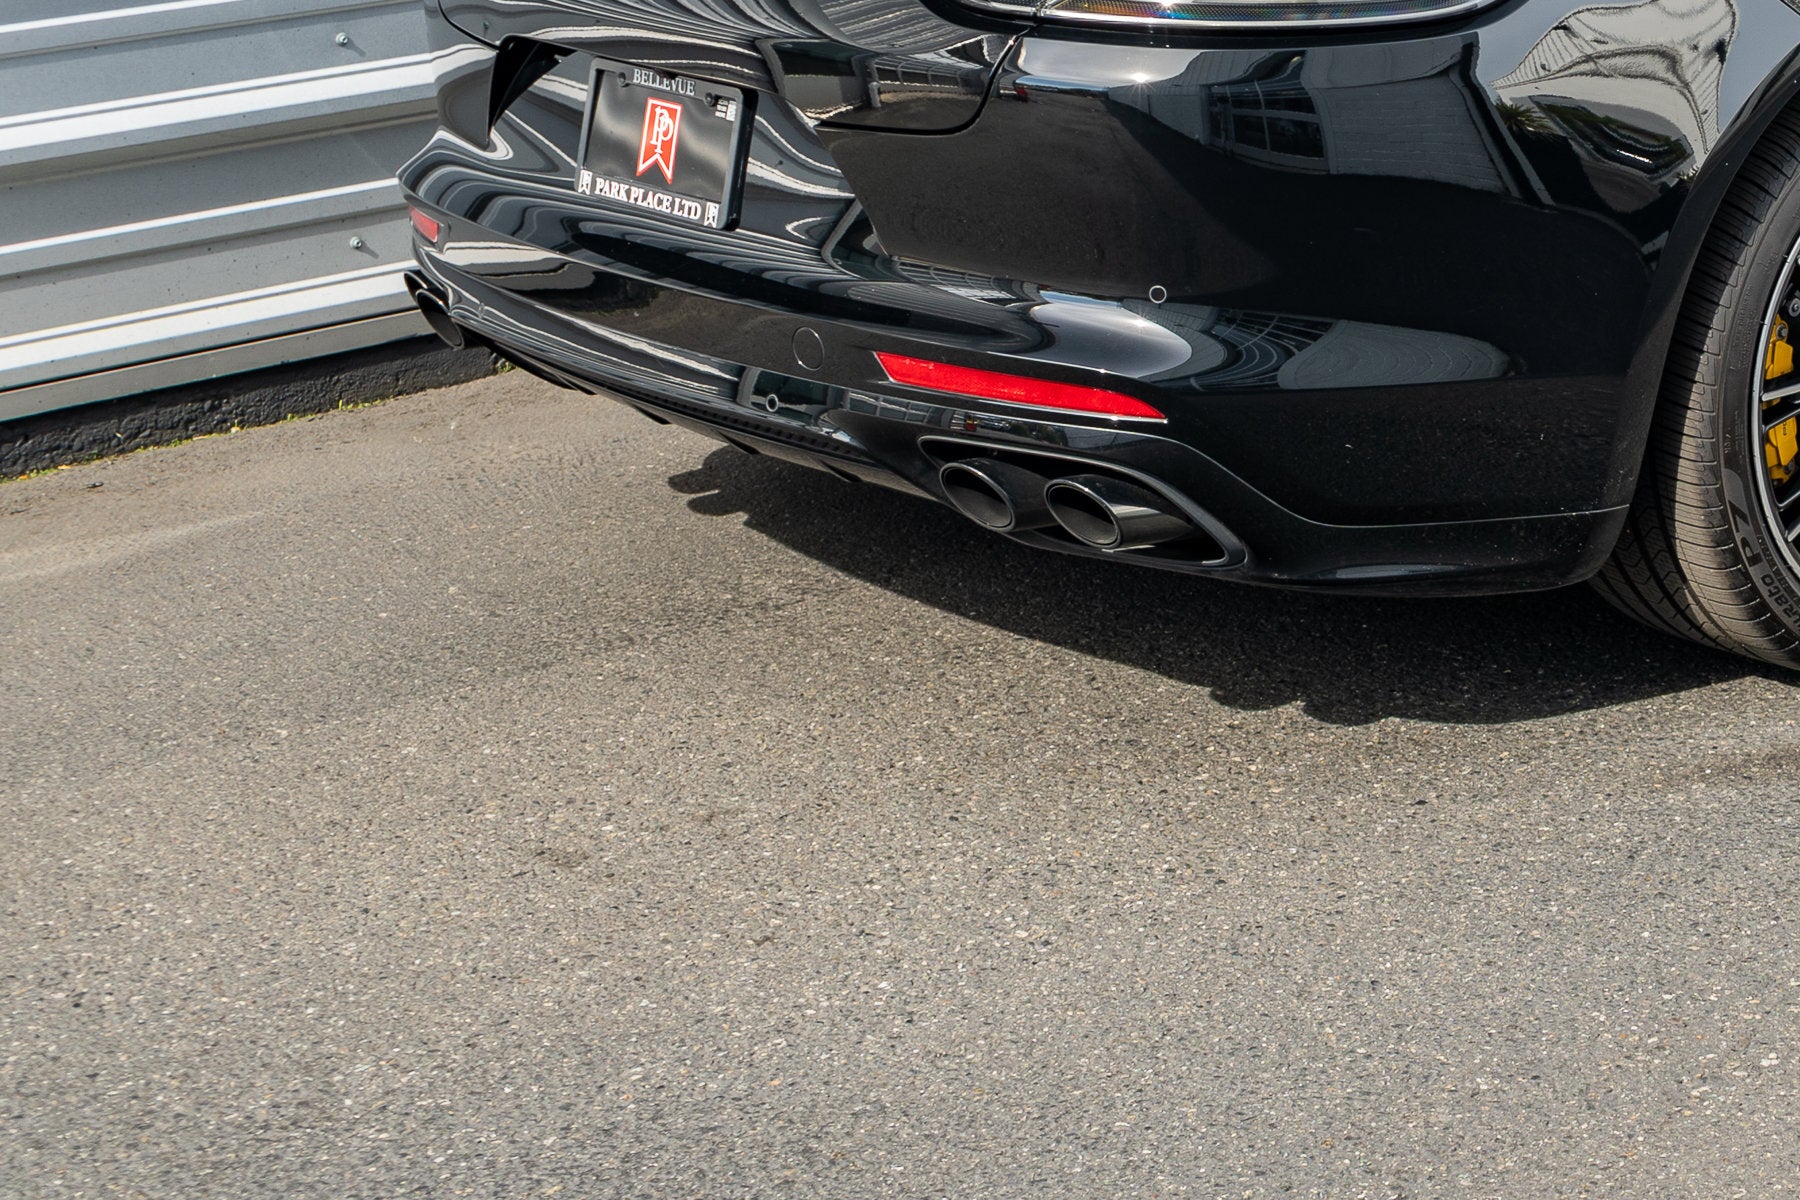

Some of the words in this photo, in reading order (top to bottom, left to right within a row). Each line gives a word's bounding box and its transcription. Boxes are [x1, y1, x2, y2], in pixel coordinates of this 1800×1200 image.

[632, 68, 696, 96] BELLEVUE
[594, 177, 629, 199] PARK
[629, 184, 673, 213] PLACE
[672, 196, 701, 220] LTD
[1728, 500, 1763, 567] P7
